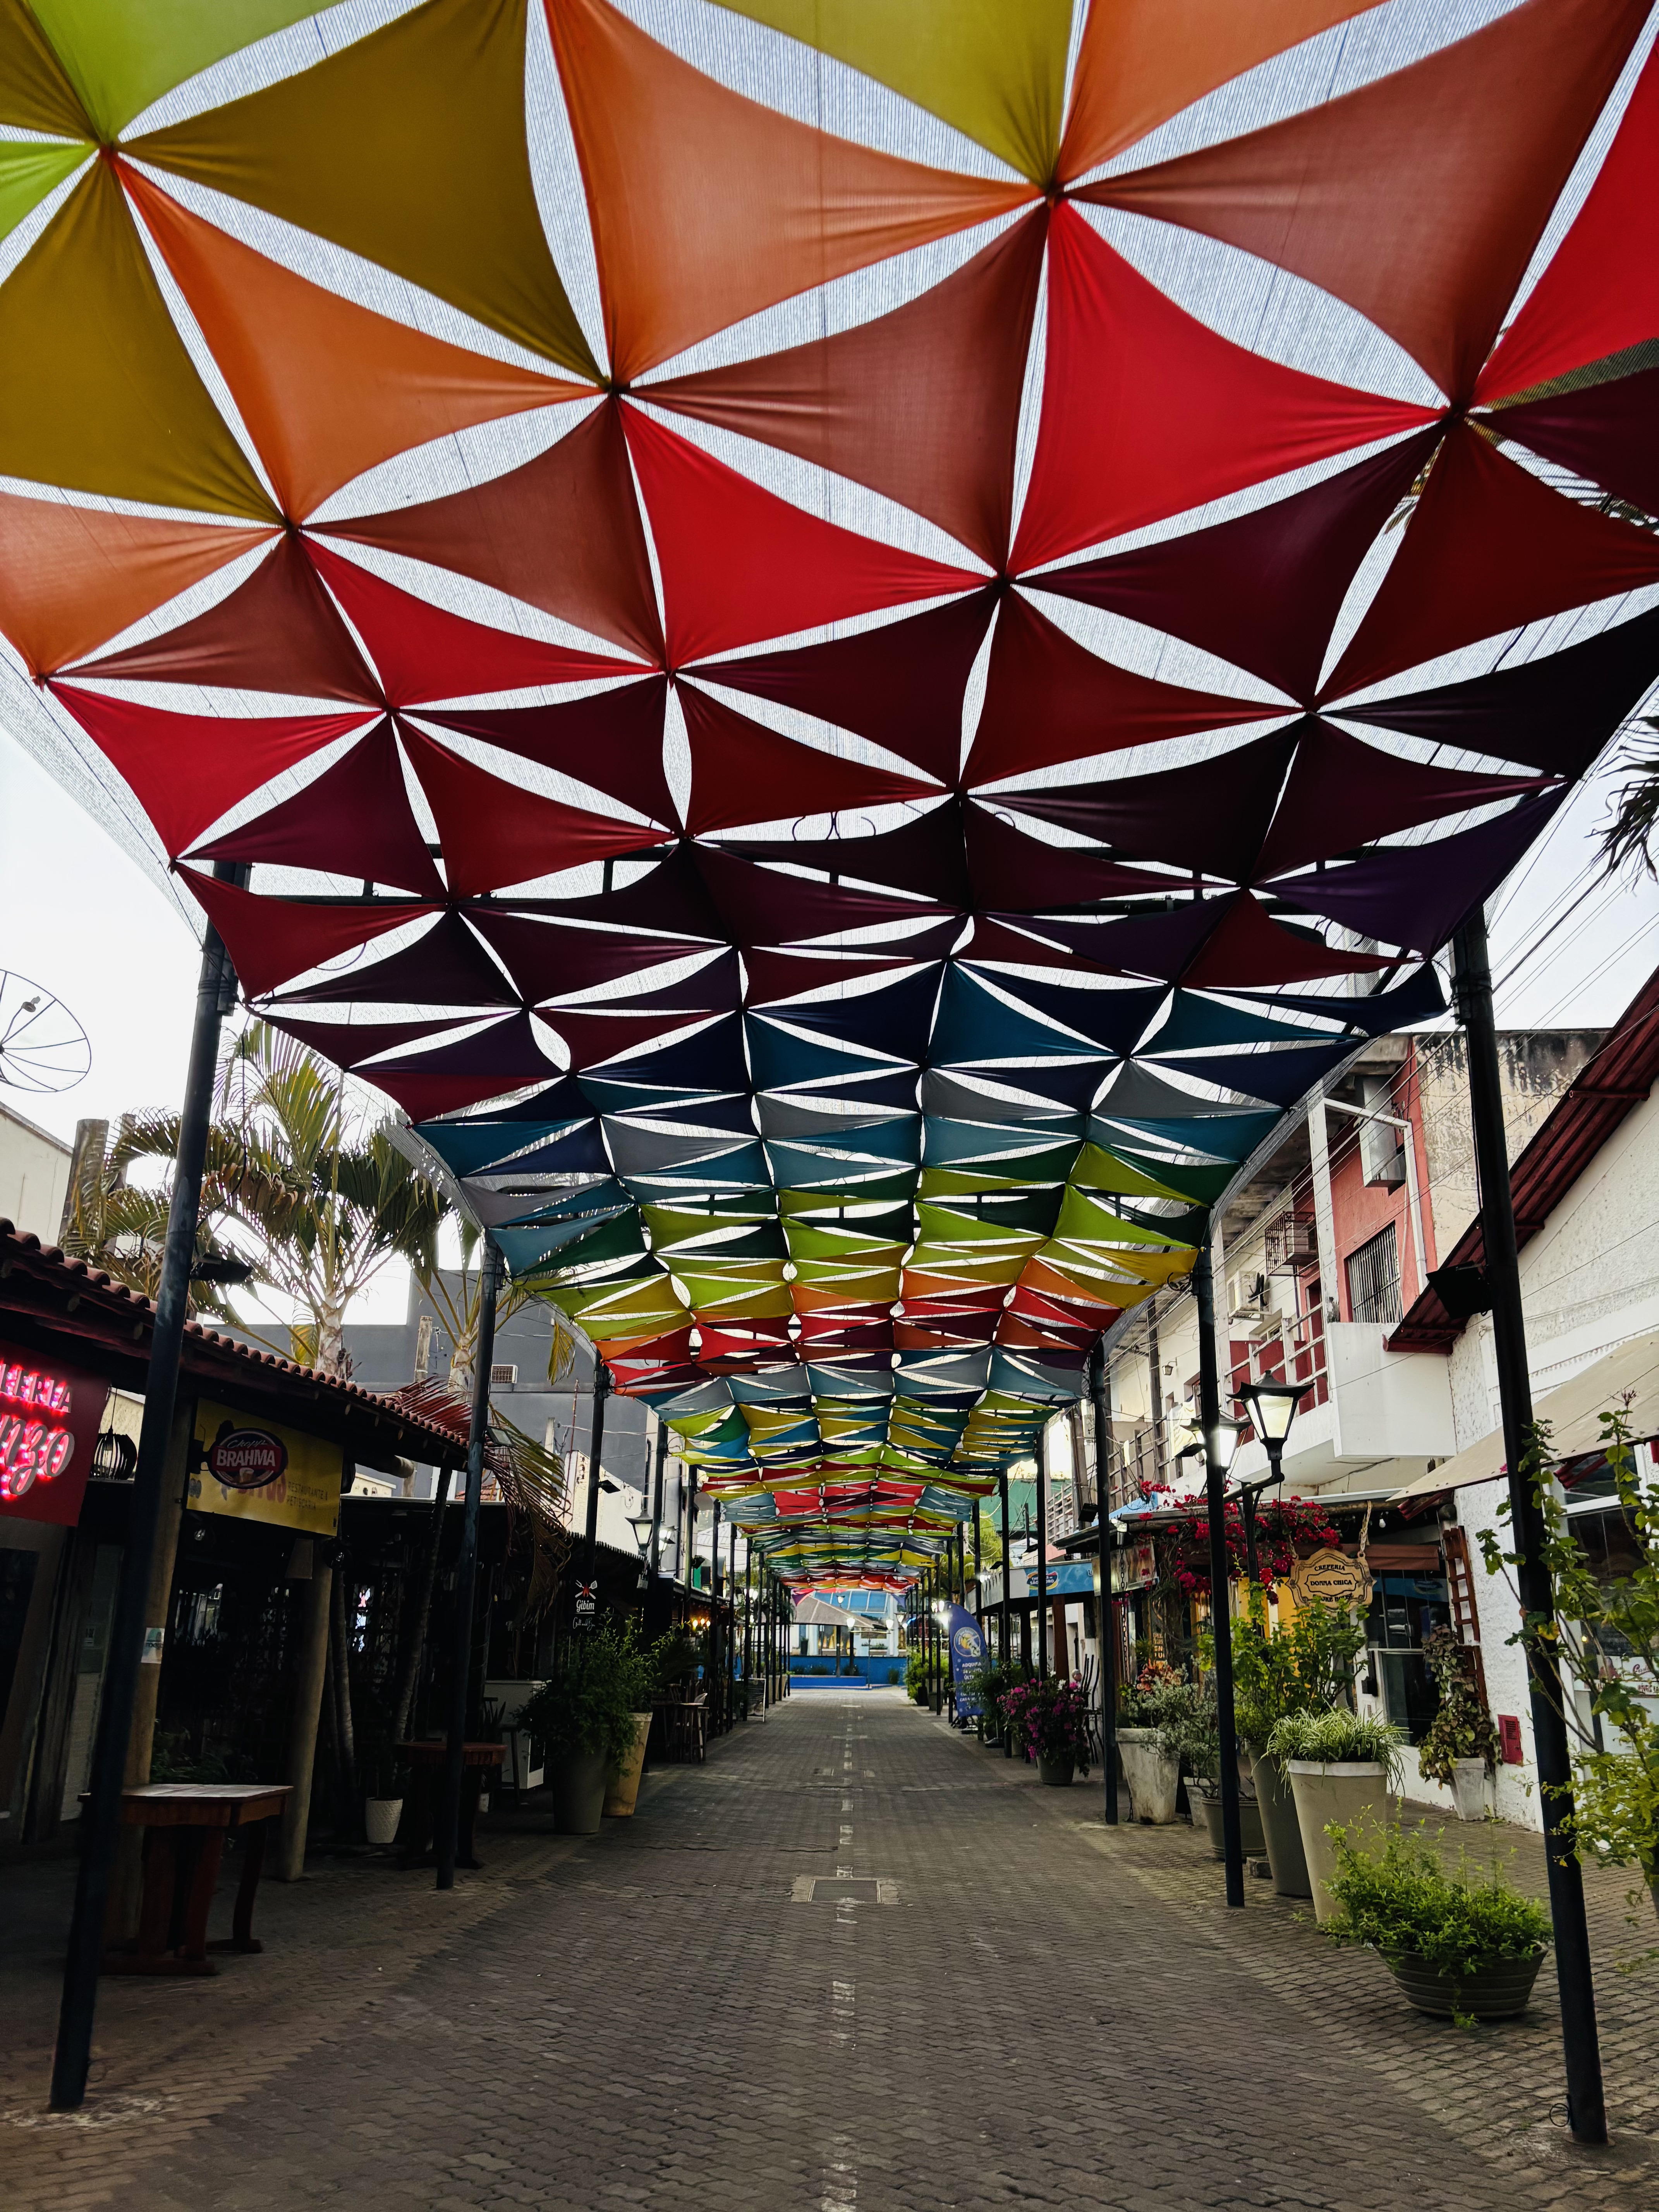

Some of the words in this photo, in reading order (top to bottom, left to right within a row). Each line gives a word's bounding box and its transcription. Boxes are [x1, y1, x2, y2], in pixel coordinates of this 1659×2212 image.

[216, 1449, 276, 1467] BRAHMA
[288, 1481, 324, 1499] RESTAURANTE
[576, 1599, 594, 1612] Gibim
